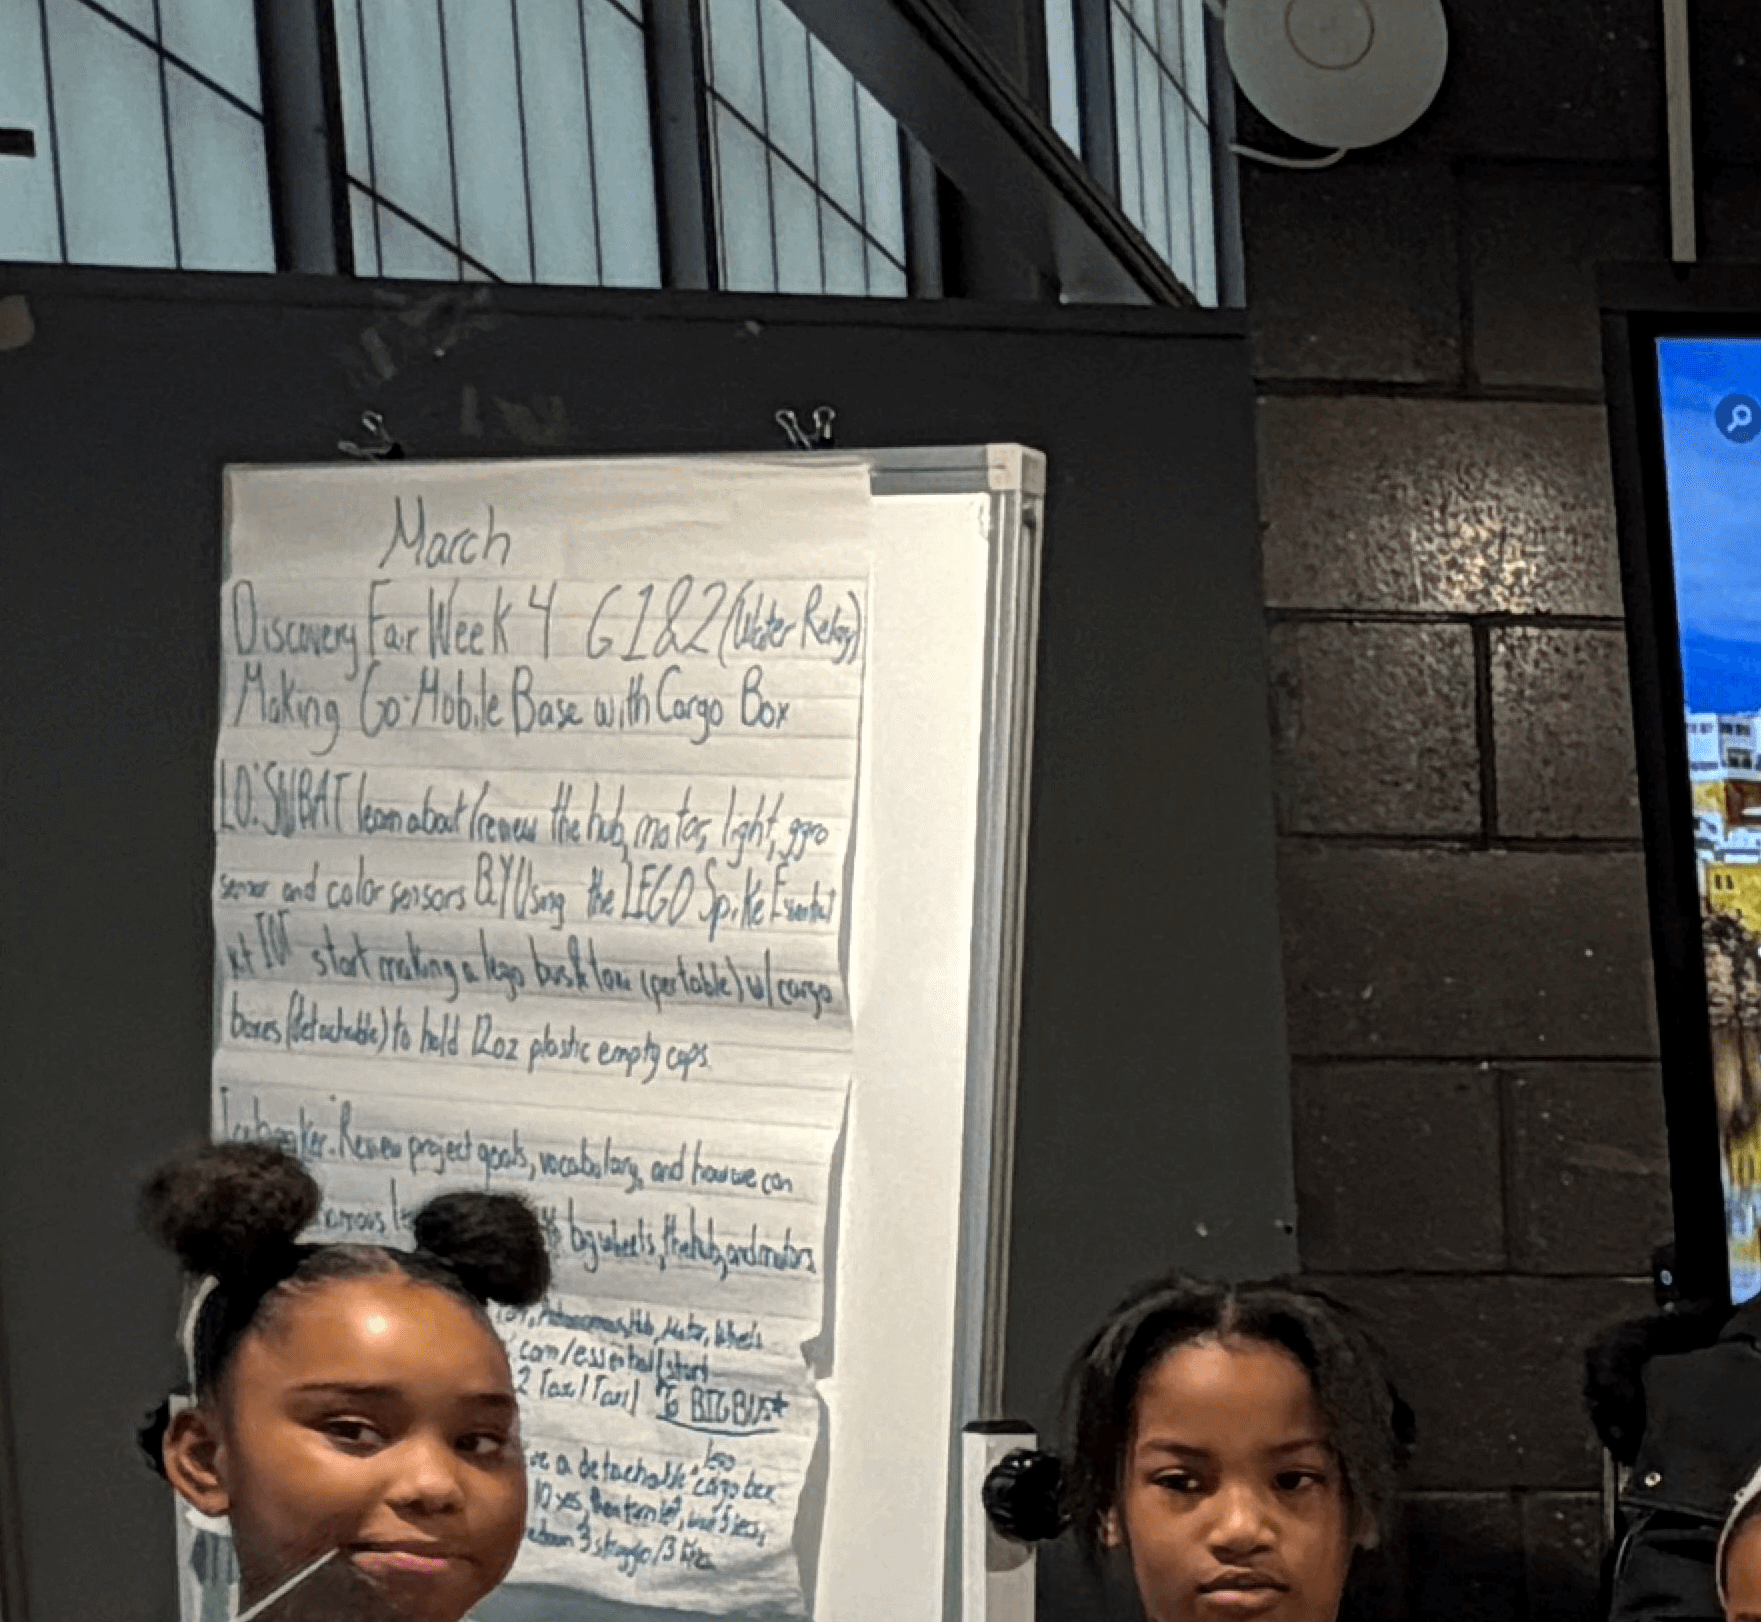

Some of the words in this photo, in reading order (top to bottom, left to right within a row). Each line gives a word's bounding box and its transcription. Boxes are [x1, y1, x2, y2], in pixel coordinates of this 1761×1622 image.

[379, 496, 511, 568] March
[232, 579, 359, 682] Discovery
[367, 578, 421, 657] Fair
[428, 577, 513, 660] Week
[528, 579, 558, 662] 4
[233, 660, 341, 758] Making
[511, 664, 583, 738] Base
[594, 672, 650, 731] with
[656, 664, 724, 746] Cargo
[741, 664, 791, 730] Box
[551, 781, 581, 845] the
[281, 860, 319, 903] and
[327, 853, 384, 909] color
[588, 866, 614, 919] the
[621, 860, 695, 927] LEGO
